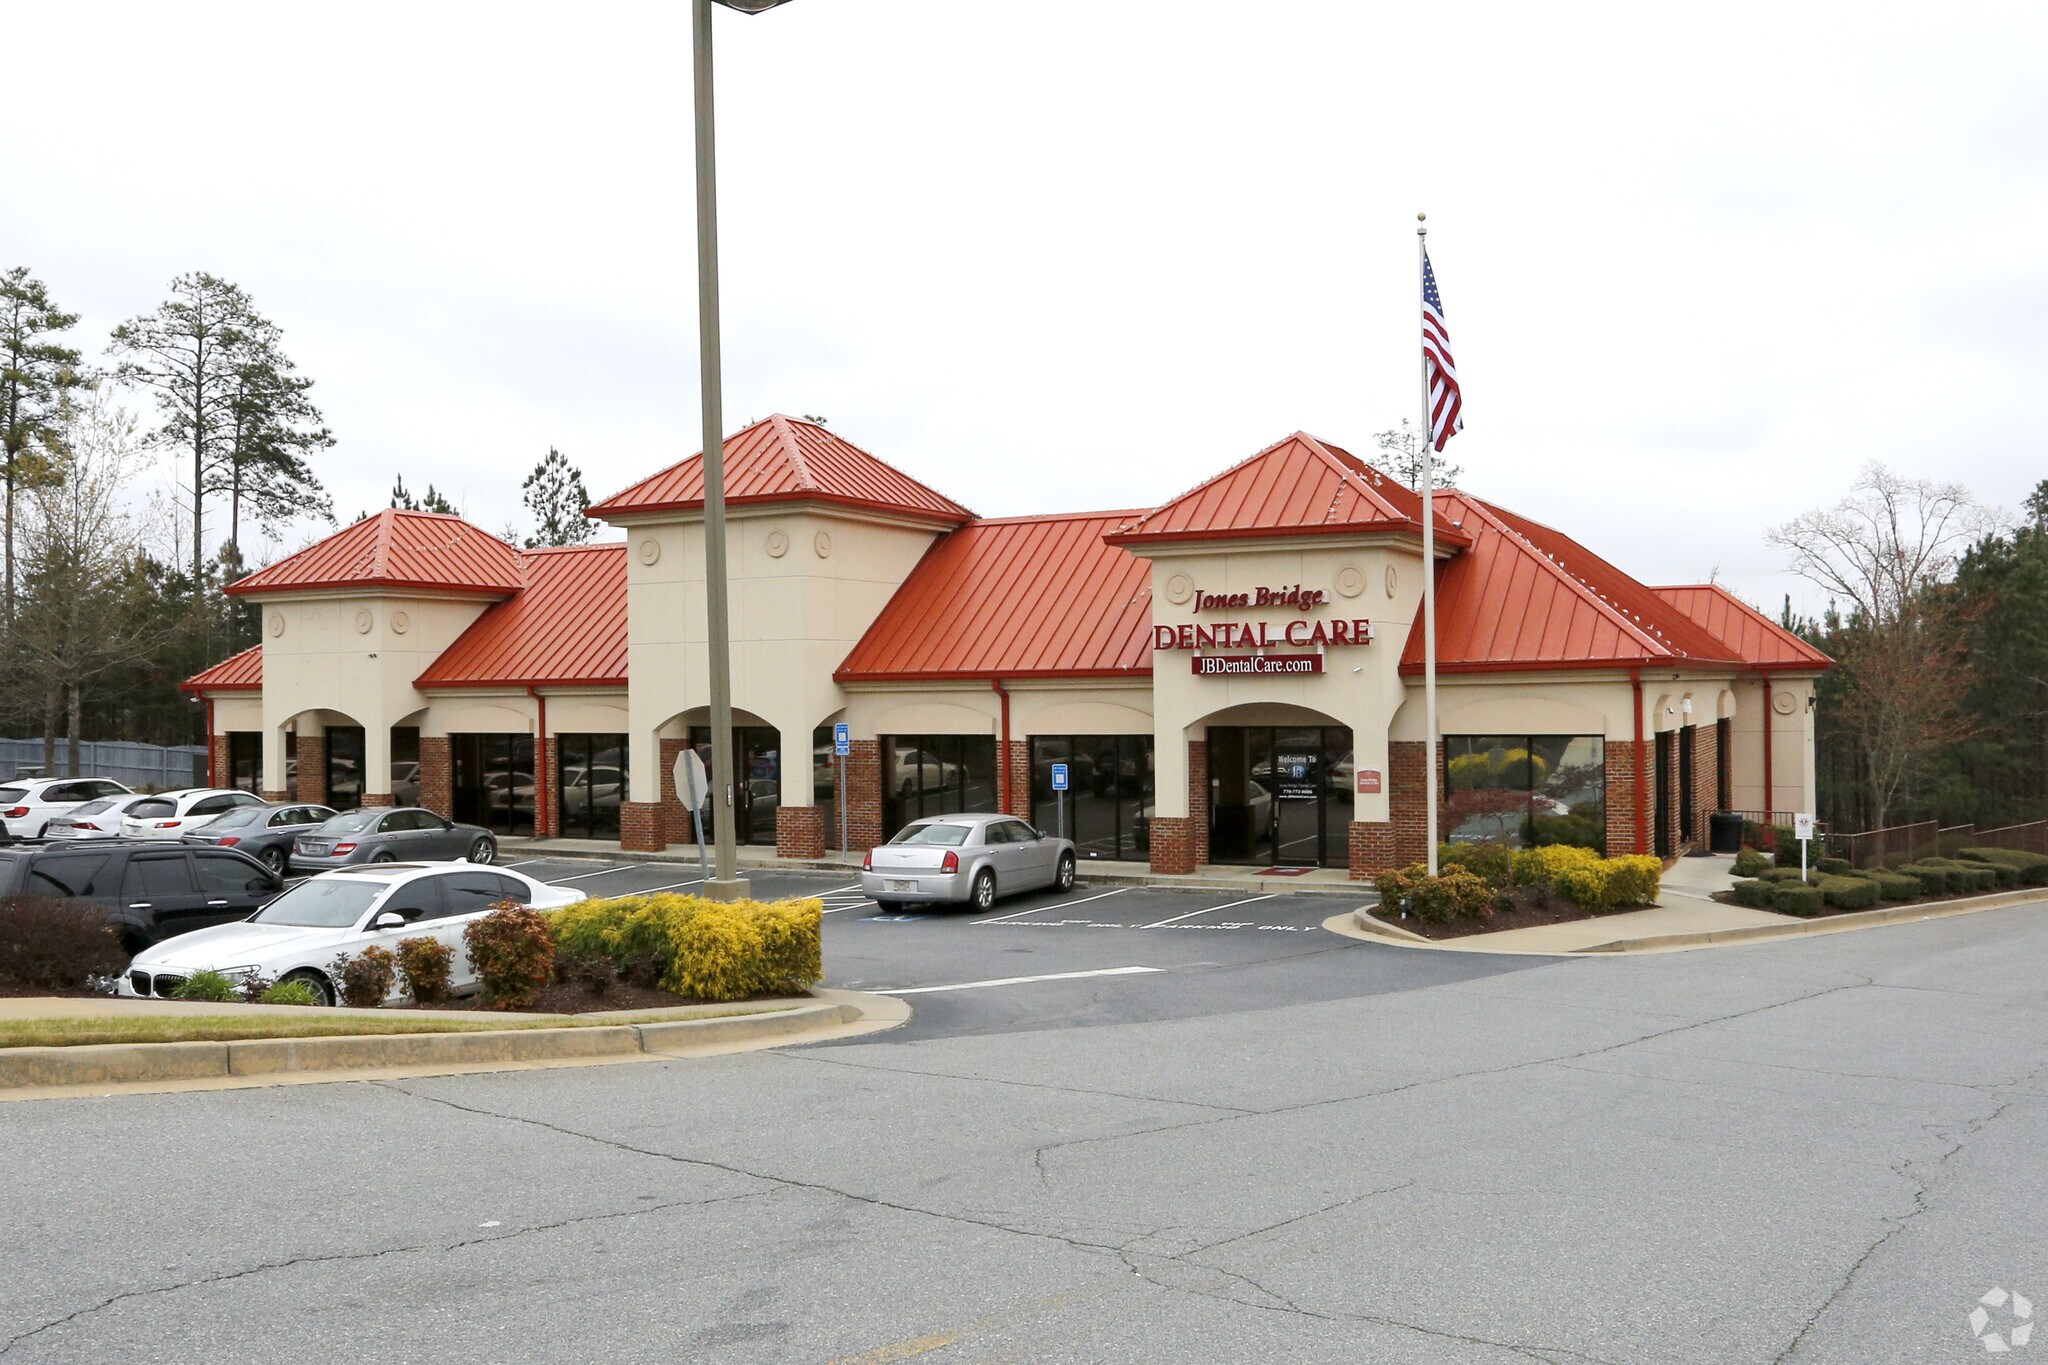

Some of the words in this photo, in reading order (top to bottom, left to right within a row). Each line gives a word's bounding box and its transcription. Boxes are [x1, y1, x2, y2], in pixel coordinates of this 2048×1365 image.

[1192, 589, 1249, 614] Jones
[1253, 584, 1324, 612] Bridge
[1153, 621, 1278, 650] DENTAL
[1285, 618, 1372, 647] CARE
[1200, 656, 1313, 674] JBDentalCare.com
[1277, 755, 1307, 763] Welcome
[1307, 755, 1317, 763] To
